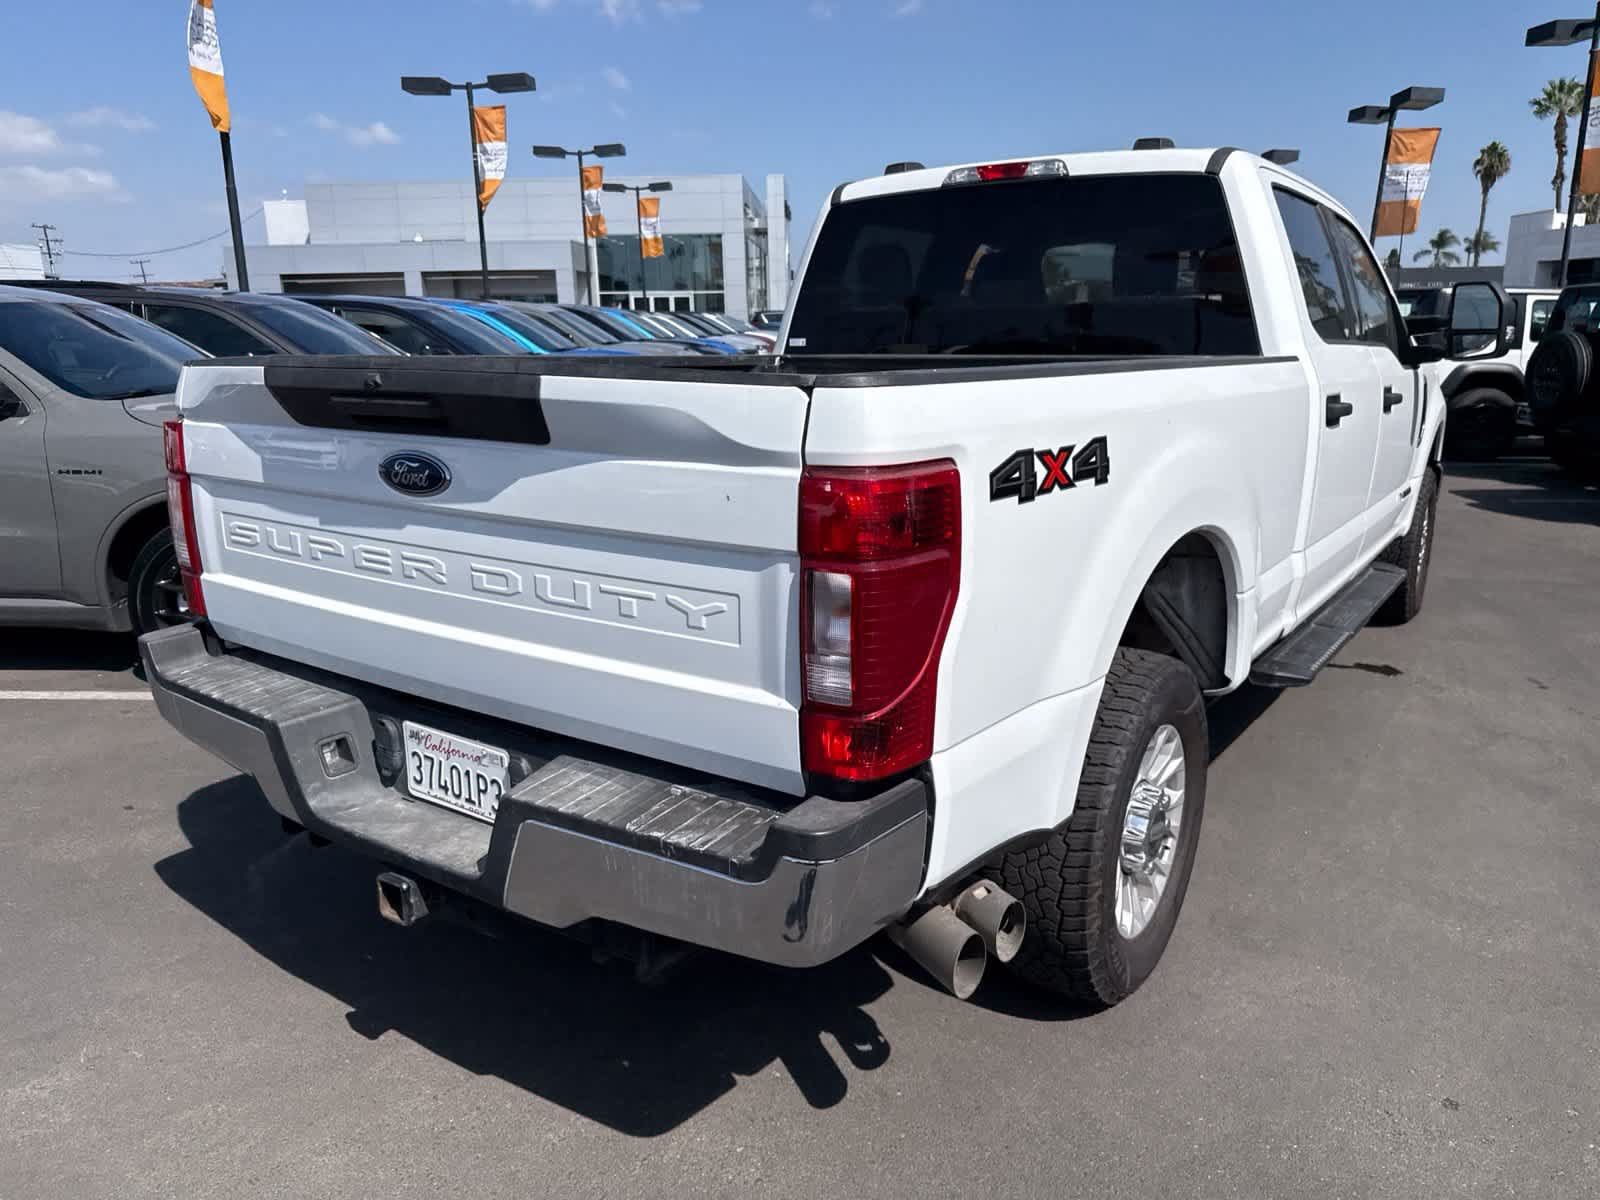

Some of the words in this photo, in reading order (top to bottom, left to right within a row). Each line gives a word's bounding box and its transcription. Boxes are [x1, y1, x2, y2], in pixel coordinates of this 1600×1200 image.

[391, 459, 429, 487] Ford
[229, 520, 448, 585] SUPER
[470, 562, 729, 630] DUTY
[424, 734, 481, 762] California
[411, 751, 502, 811] 37401P3
